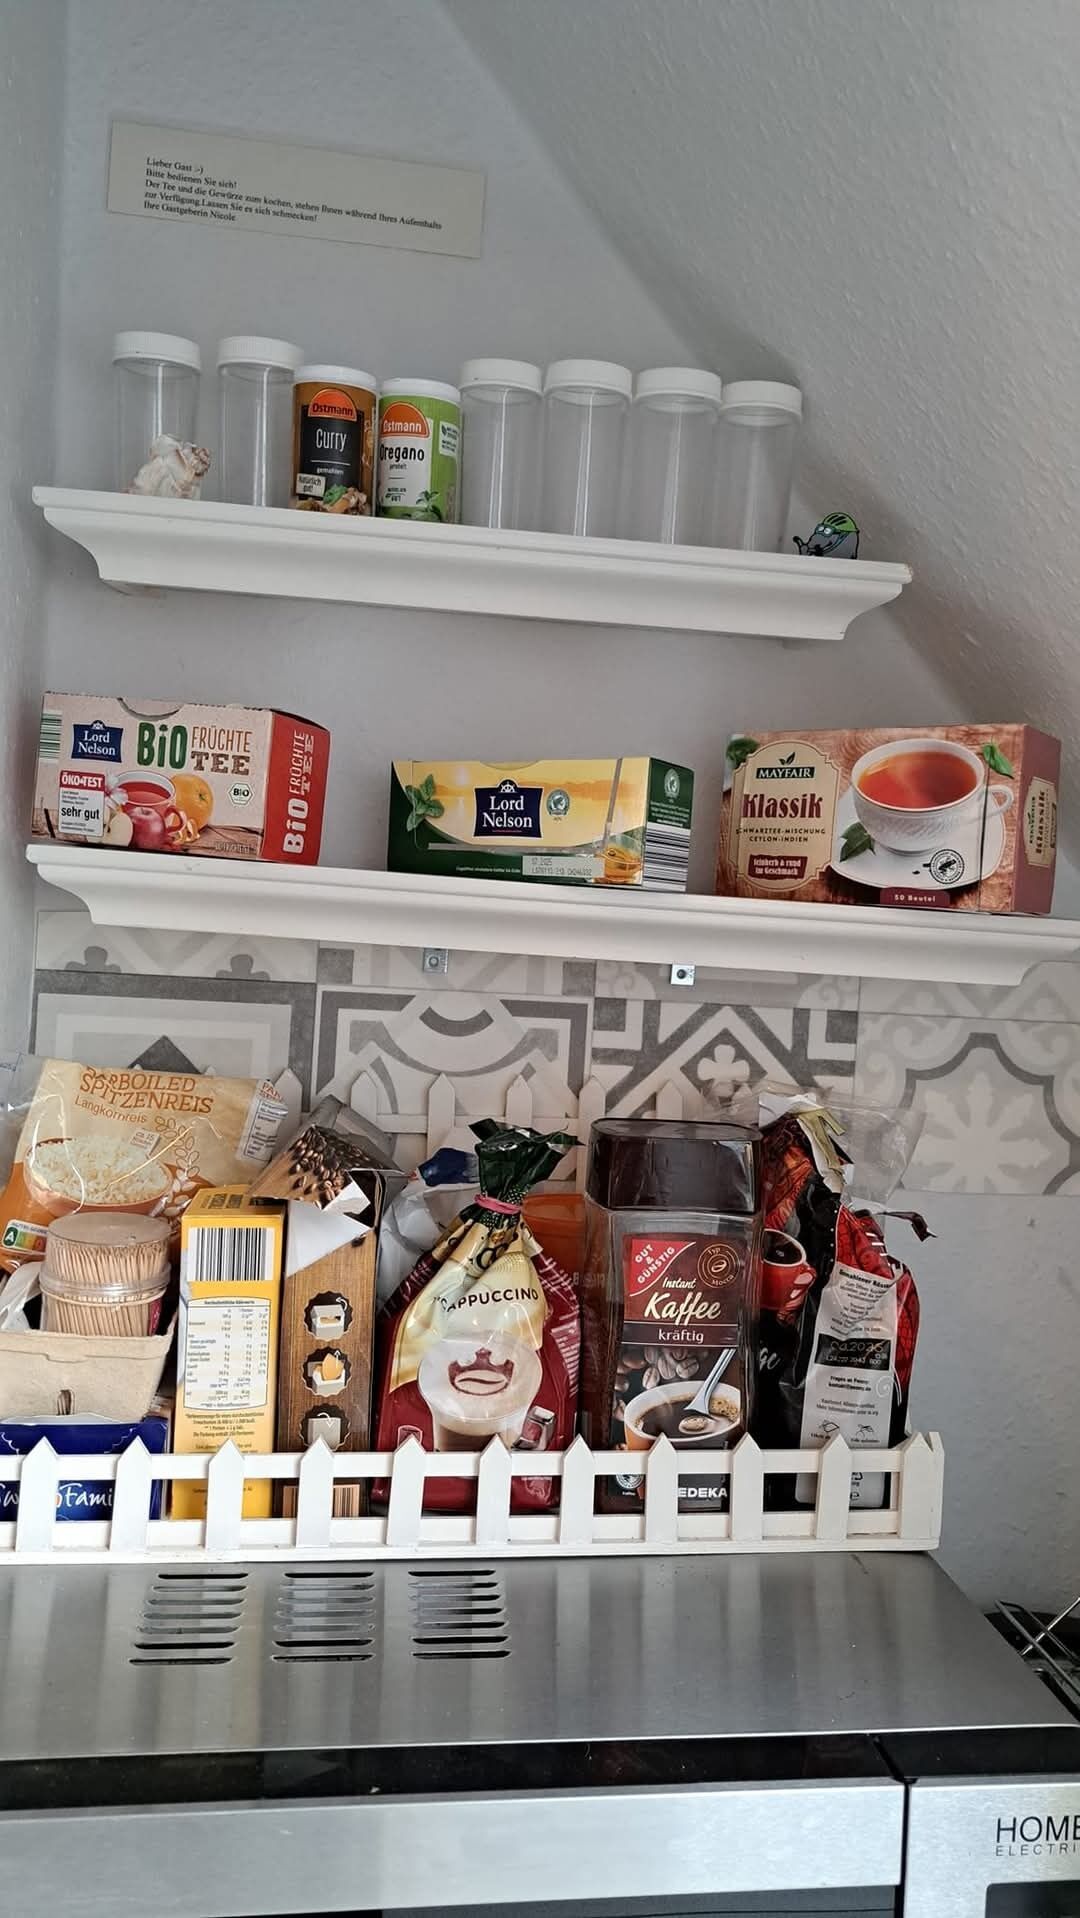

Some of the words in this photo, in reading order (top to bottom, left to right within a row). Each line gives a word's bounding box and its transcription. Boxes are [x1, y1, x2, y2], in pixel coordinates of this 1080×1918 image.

[146, 157, 172, 168] Lieber
[174, 161, 192, 171] Gast
[146, 168, 165, 178] Bitte
[167, 171, 202, 184] bedienen
[204, 177, 217, 186] Sie
[144, 191, 157, 199] zur
[230, 203, 243, 212] Sie
[244, 205, 253, 213] es
[254, 207, 271, 216] sich
[145, 179, 160, 188] Der
[162, 181, 176, 191] Tee
[178, 184, 192, 194] und
[194, 187, 207, 196] die
[208, 188, 243, 200] Gewürze
[245, 194, 262, 202] zum
[295, 202, 319, 212] stehen
[321, 204, 343, 215] Ihnen
[144, 200, 160, 210] Ihre
[161, 203, 209, 217] Gastgeberin
[210, 210, 236, 221] Nicole
[312, 402, 354, 416] Ostmann
[383, 419, 422, 432] Ostmann
[316, 428, 347, 452] Curry
[379, 444, 425, 462] Oregano
[84, 730, 110, 743] Lord
[191, 725, 253, 752] FRÜCHTE
[78, 742, 116, 756] Nelson
[190, 751, 250, 775] TEE
[759, 768, 811, 778] MAYFAIR
[489, 796, 524, 811] Lord
[743, 793, 823, 818] Klassik
[61, 806, 81, 817] sehr
[84, 809, 100, 821] gut
[483, 812, 533, 829] Nelson
[80, 1073, 214, 1114] SPITZENREIS
[75, 1095, 148, 1123] Langkornreis
[635, 1243, 653, 1264] GUT
[646, 1256, 654, 1265] &
[662, 1277, 697, 1289] Instant
[644, 1291, 721, 1326] Kaffee
[658, 1328, 704, 1344] kräftig
[676, 1487, 728, 1498] EDEKA
[996, 1815, 1080, 1843] HOME
